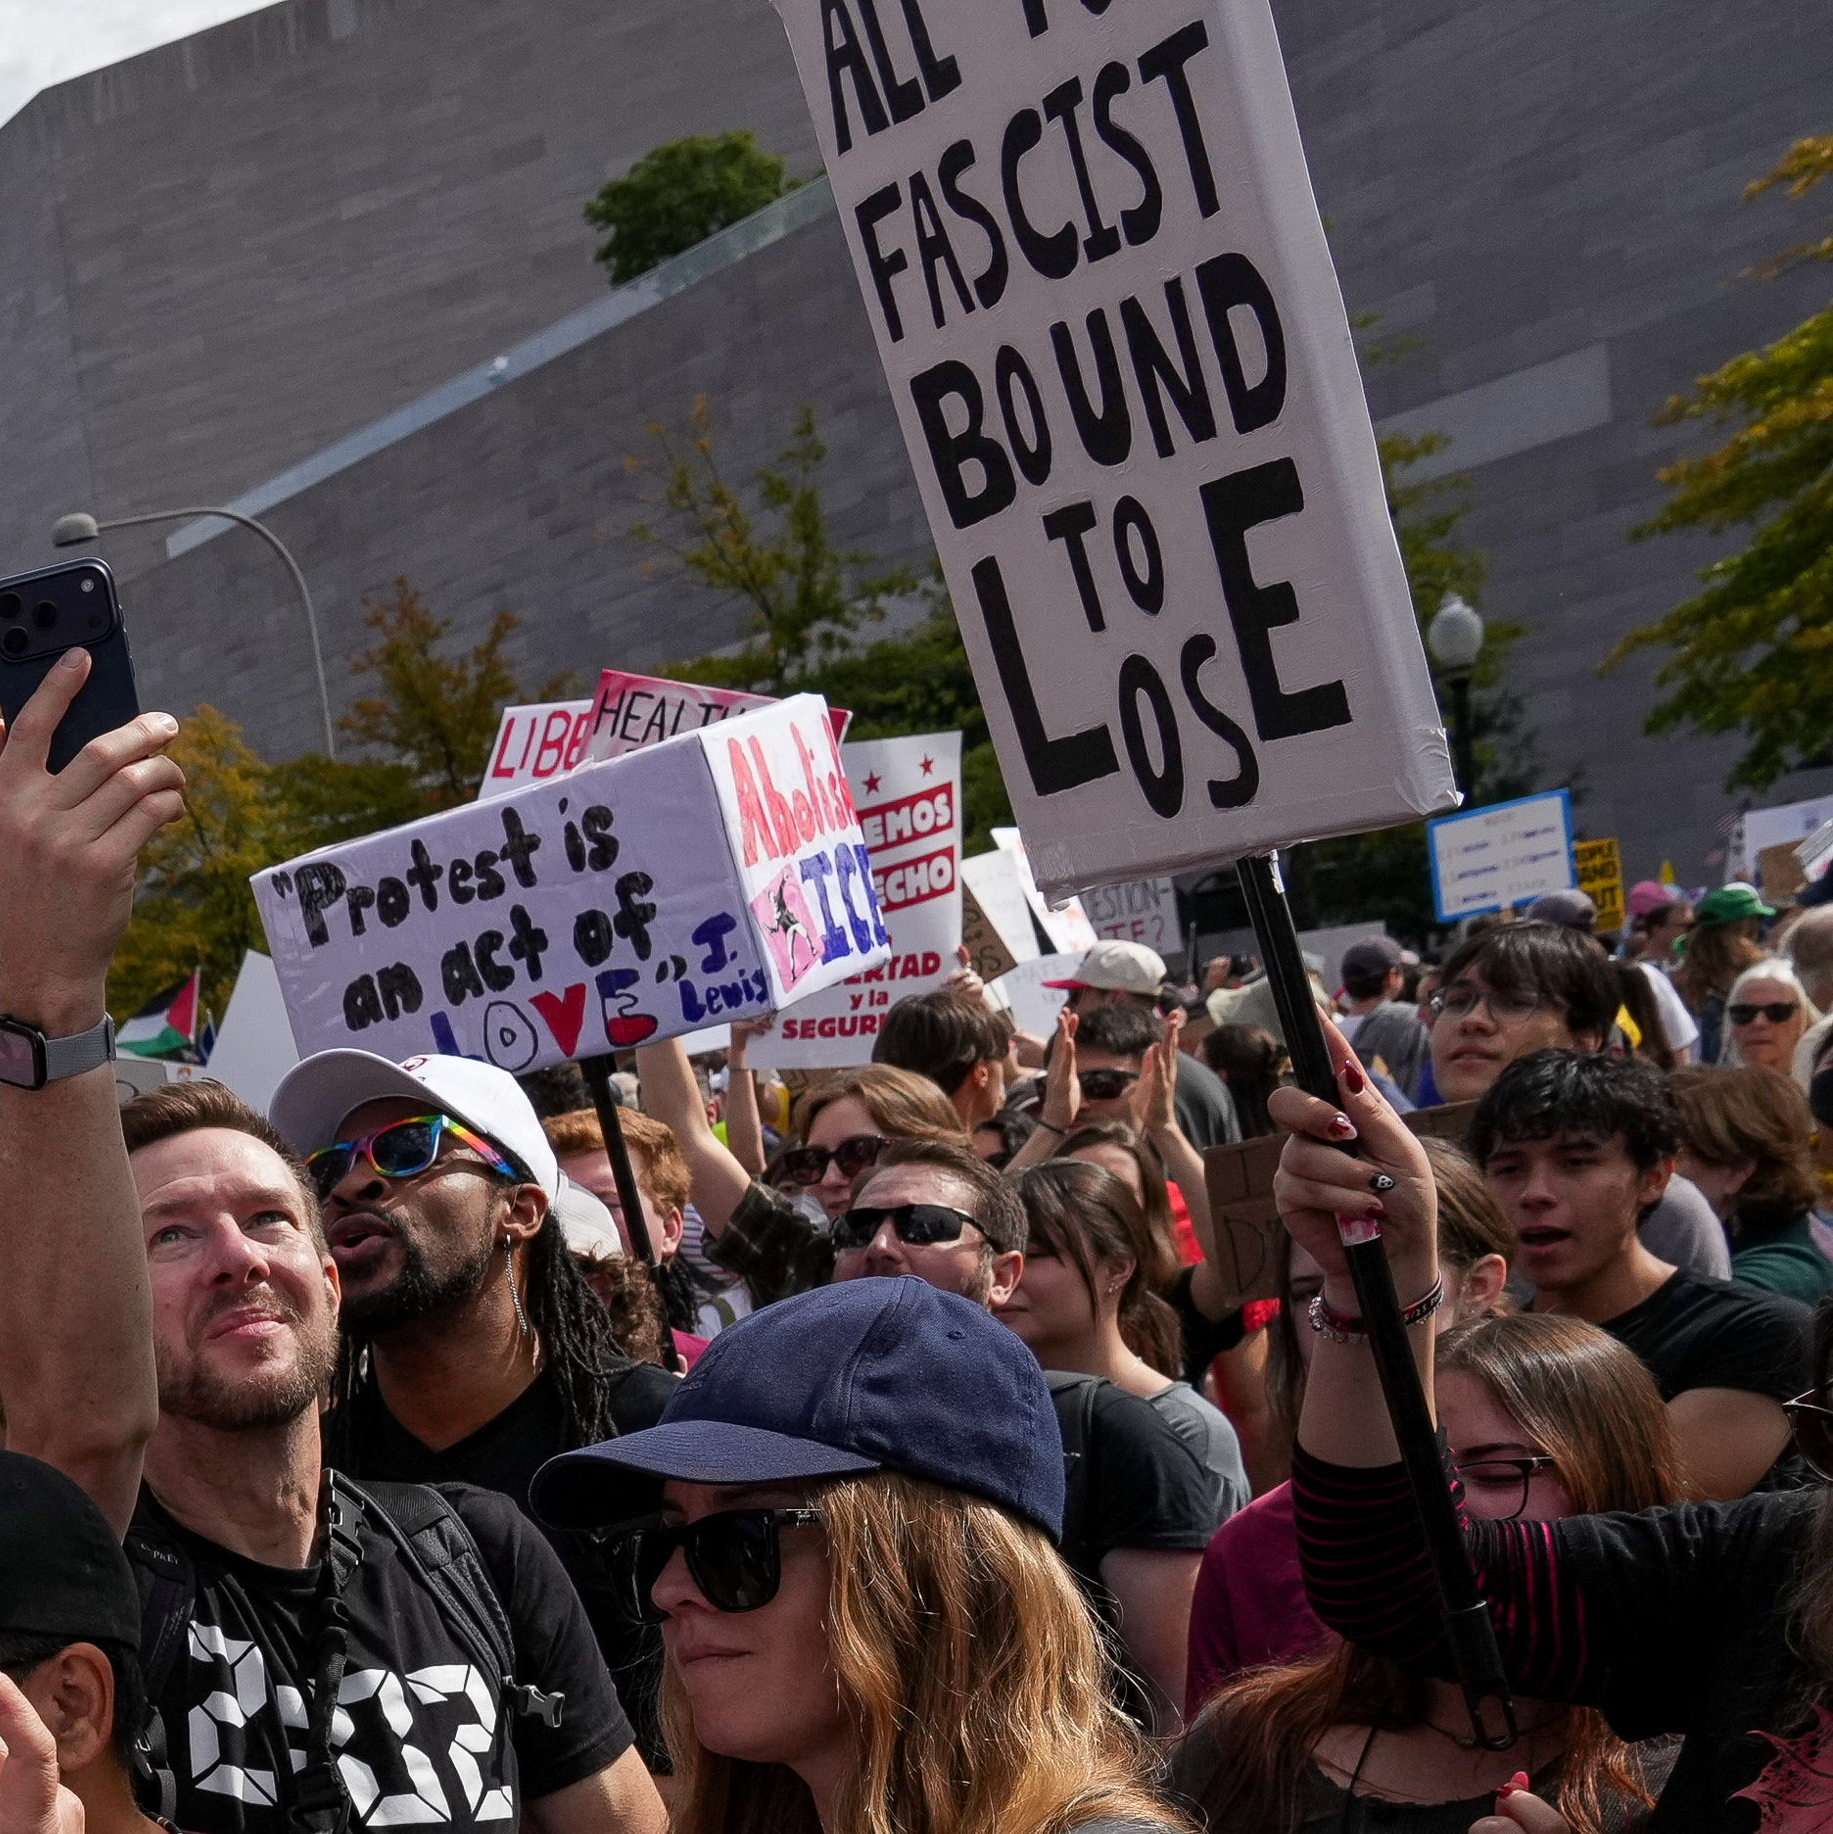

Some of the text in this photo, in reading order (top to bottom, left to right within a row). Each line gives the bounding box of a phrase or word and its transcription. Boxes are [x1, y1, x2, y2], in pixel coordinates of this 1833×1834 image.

[854, 19, 1222, 345] FASCIST
[910, 252, 1289, 531] BOUND
[1042, 494, 1166, 633] TO
[971, 456, 1354, 821] LOSE
[727, 713, 858, 867] Abolish
[864, 792, 952, 846] EMOS
[271, 797, 620, 948] "Protest is
[874, 854, 953, 908] ECHO
[342, 871, 657, 1031] an act of
[678, 969, 769, 1023] Lewis
[845, 952, 941, 985] ERTAD
[850, 988, 889, 1011] y la
